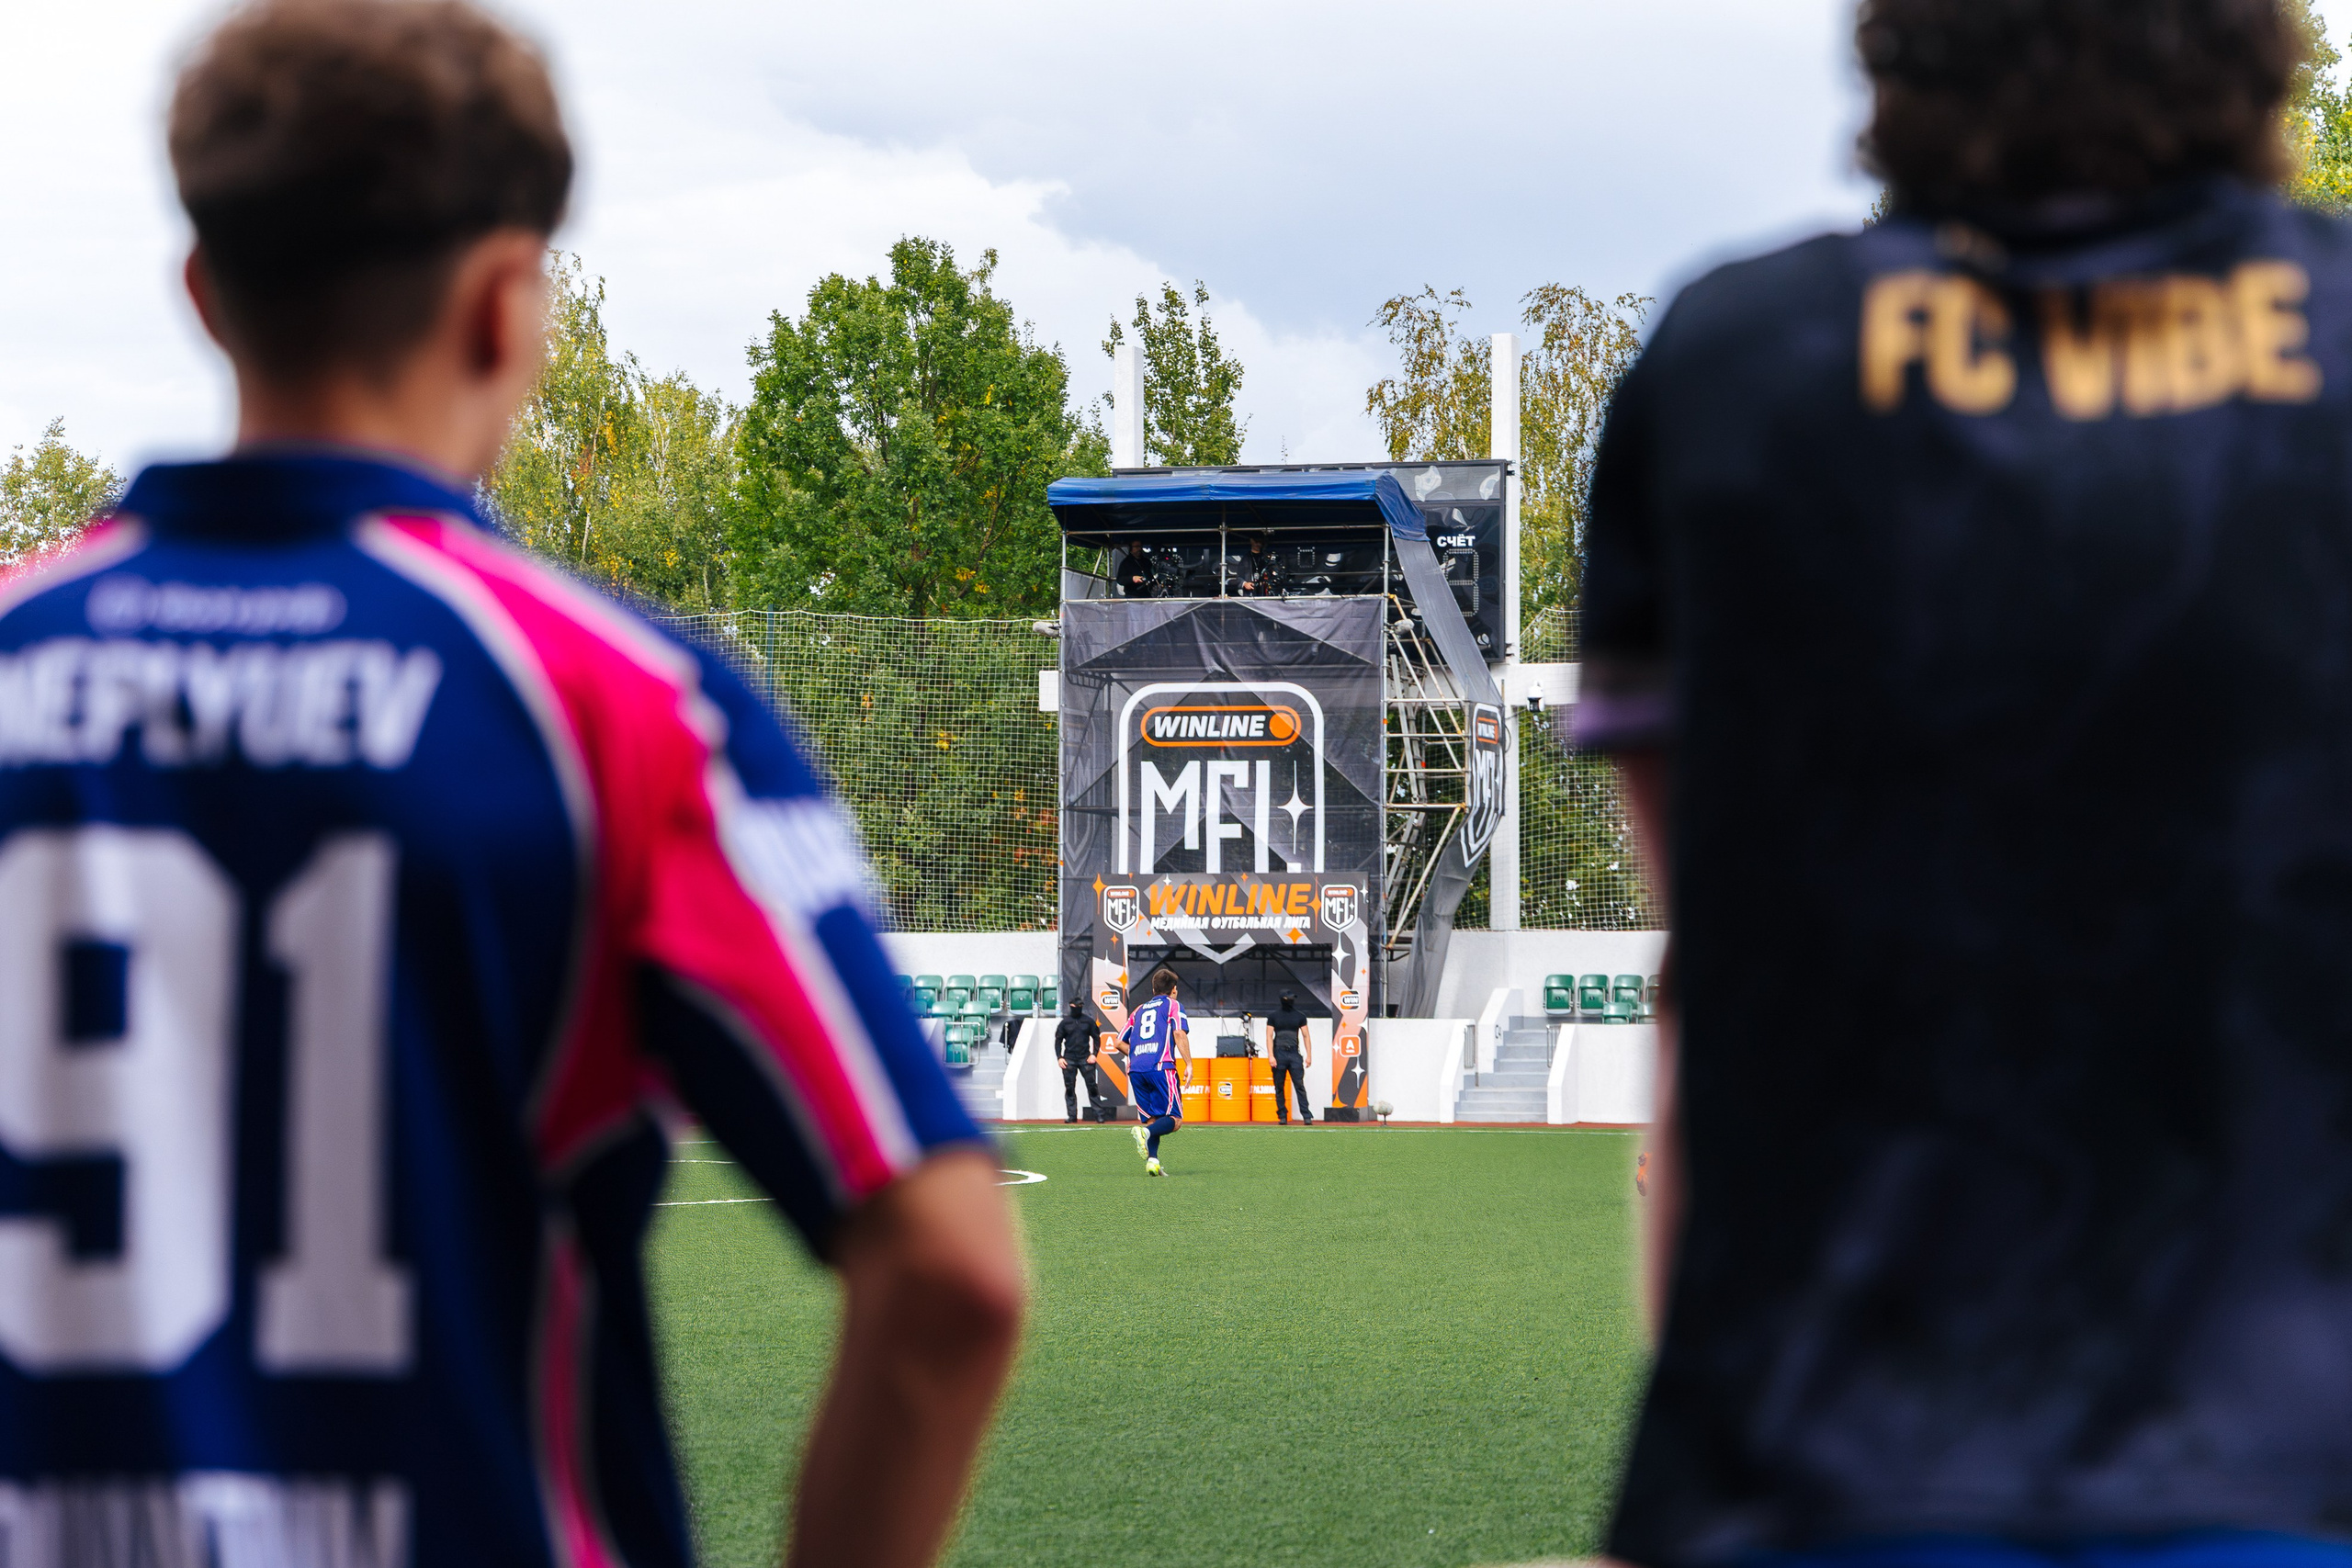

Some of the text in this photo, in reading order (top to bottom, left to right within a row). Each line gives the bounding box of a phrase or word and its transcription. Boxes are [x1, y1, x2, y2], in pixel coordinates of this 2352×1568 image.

[1860, 258, 2323, 421] FC VIBE
[1436, 534, 1476, 547] СЧЁТ
[1153, 715, 1266, 738] WINLINE
[1139, 761, 1302, 874] MFL
[1107, 898, 1136, 930] MFL
[1149, 882, 1311, 915] WINLINE
[1325, 897, 1354, 930] MFL
[1150, 915, 1311, 931] МЕДИЙНАЯ ФУТБОЛЬНАЯ ЛИГА
[1140, 1009, 1157, 1040] 8
[0, 829, 413, 1374] 91
